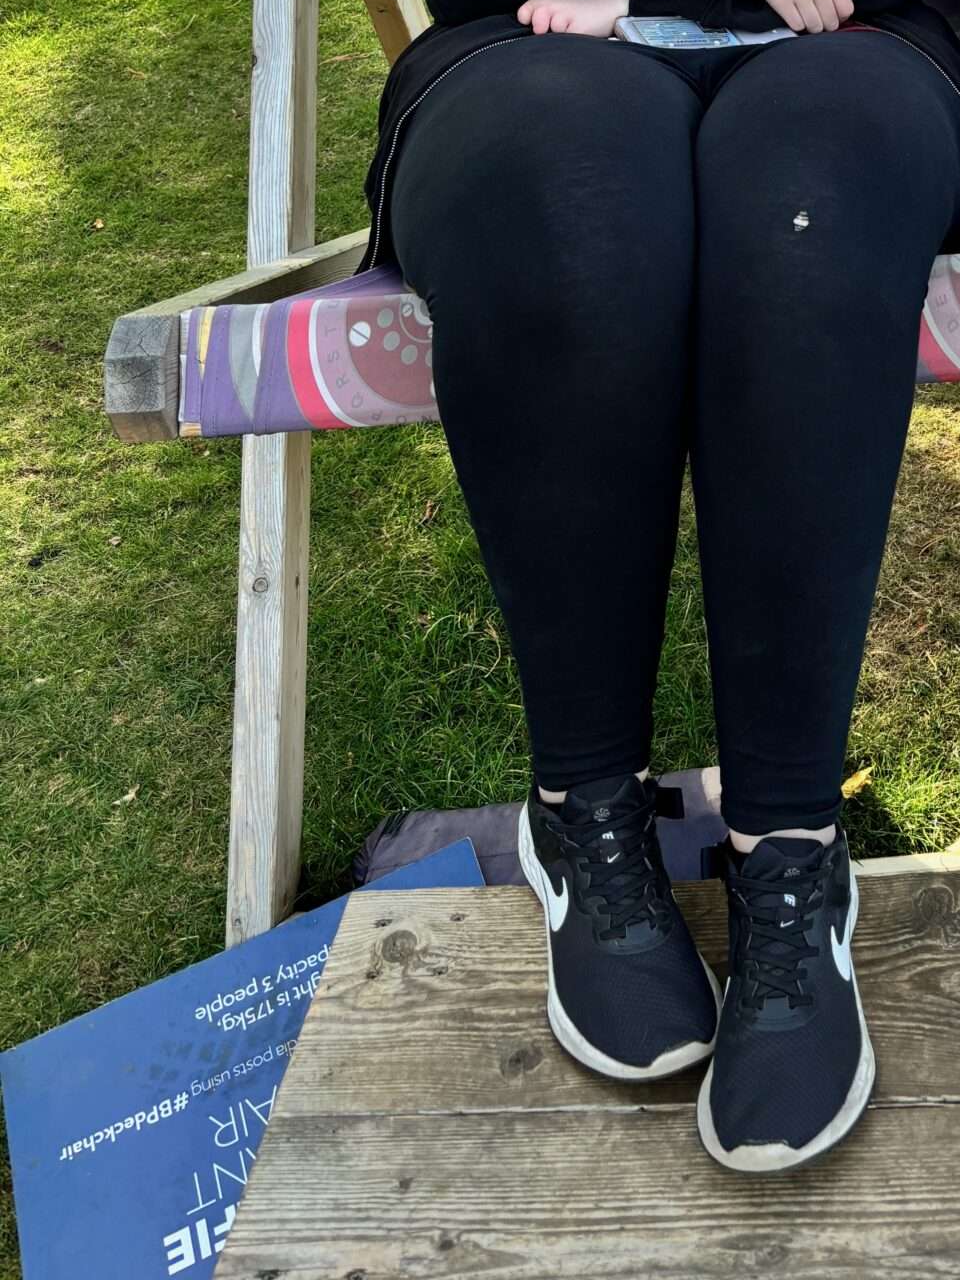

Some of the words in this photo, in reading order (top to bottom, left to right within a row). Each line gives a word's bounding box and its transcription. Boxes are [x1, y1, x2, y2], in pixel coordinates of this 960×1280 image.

[276, 943, 332, 983] pacity
[194, 977, 259, 1023] people
[262, 975, 274, 993] 3
[276, 991, 292, 1007] is
[232, 1045, 273, 1075] posts
[191, 1070, 231, 1096] using
[59, 1091, 189, 1160] #BPdeckchair
[208, 1085, 277, 1148] AIR
[163, 1201, 241, 1276] FIE
